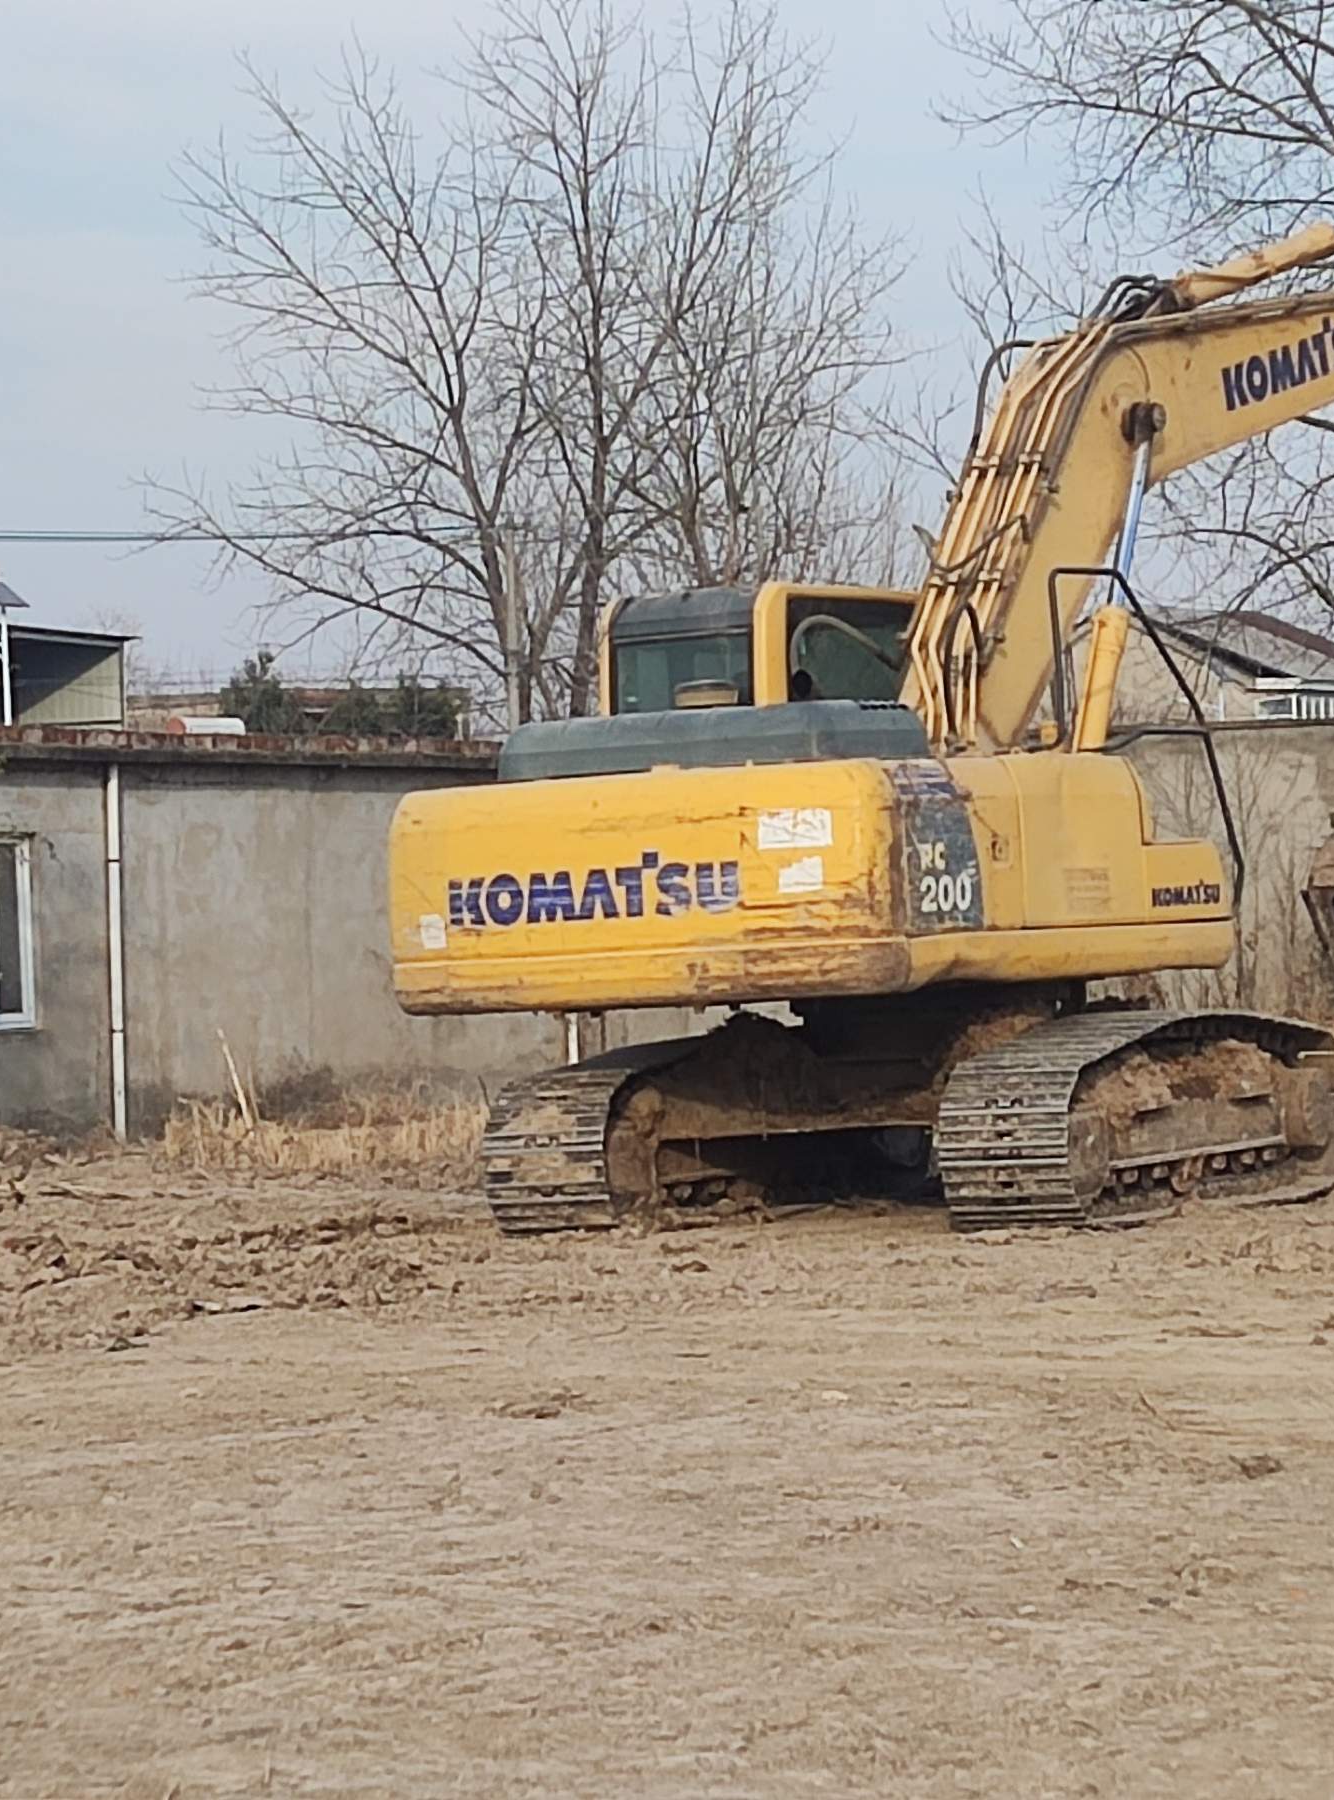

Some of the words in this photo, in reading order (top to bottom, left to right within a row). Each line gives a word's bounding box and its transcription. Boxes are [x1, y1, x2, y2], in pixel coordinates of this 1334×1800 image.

[448, 851, 739, 926] KOMATSU
[919, 873, 972, 913] 200
[1151, 878, 1220, 907] KOMATSU
